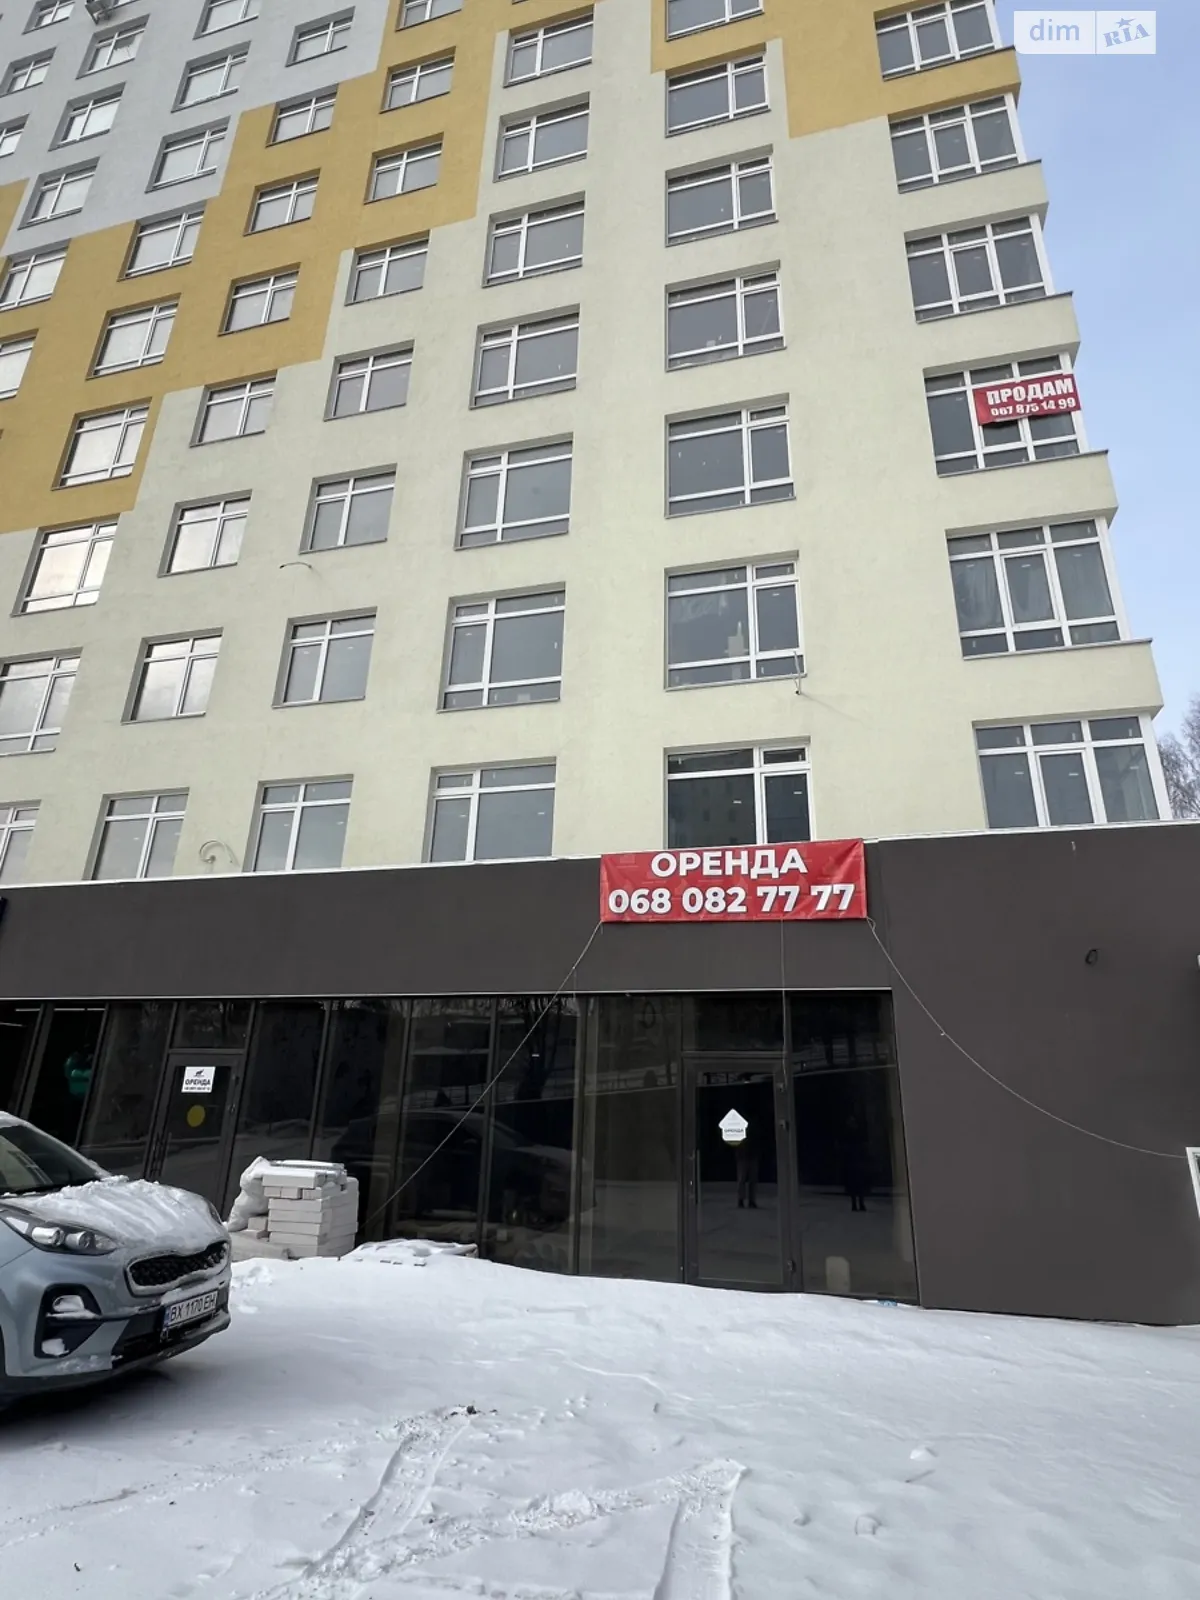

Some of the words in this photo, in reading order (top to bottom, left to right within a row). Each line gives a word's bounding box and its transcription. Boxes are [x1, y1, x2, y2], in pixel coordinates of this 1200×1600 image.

[986, 378, 1075, 406] ПРОДАМ
[990, 405, 1014, 417] 067
[1015, 402, 1040, 414] 875
[1041, 399, 1057, 411] 14
[1058, 397, 1077, 410] 99
[651, 848, 808, 880] ОРЕНДА
[608, 886, 672, 915] 068
[681, 885, 748, 914] 082
[756, 884, 800, 913] 77
[810, 883, 856, 912] 77
[184, 1078, 211, 1087] ОРЕНДА
[185, 1299, 204, 1316] 1170
